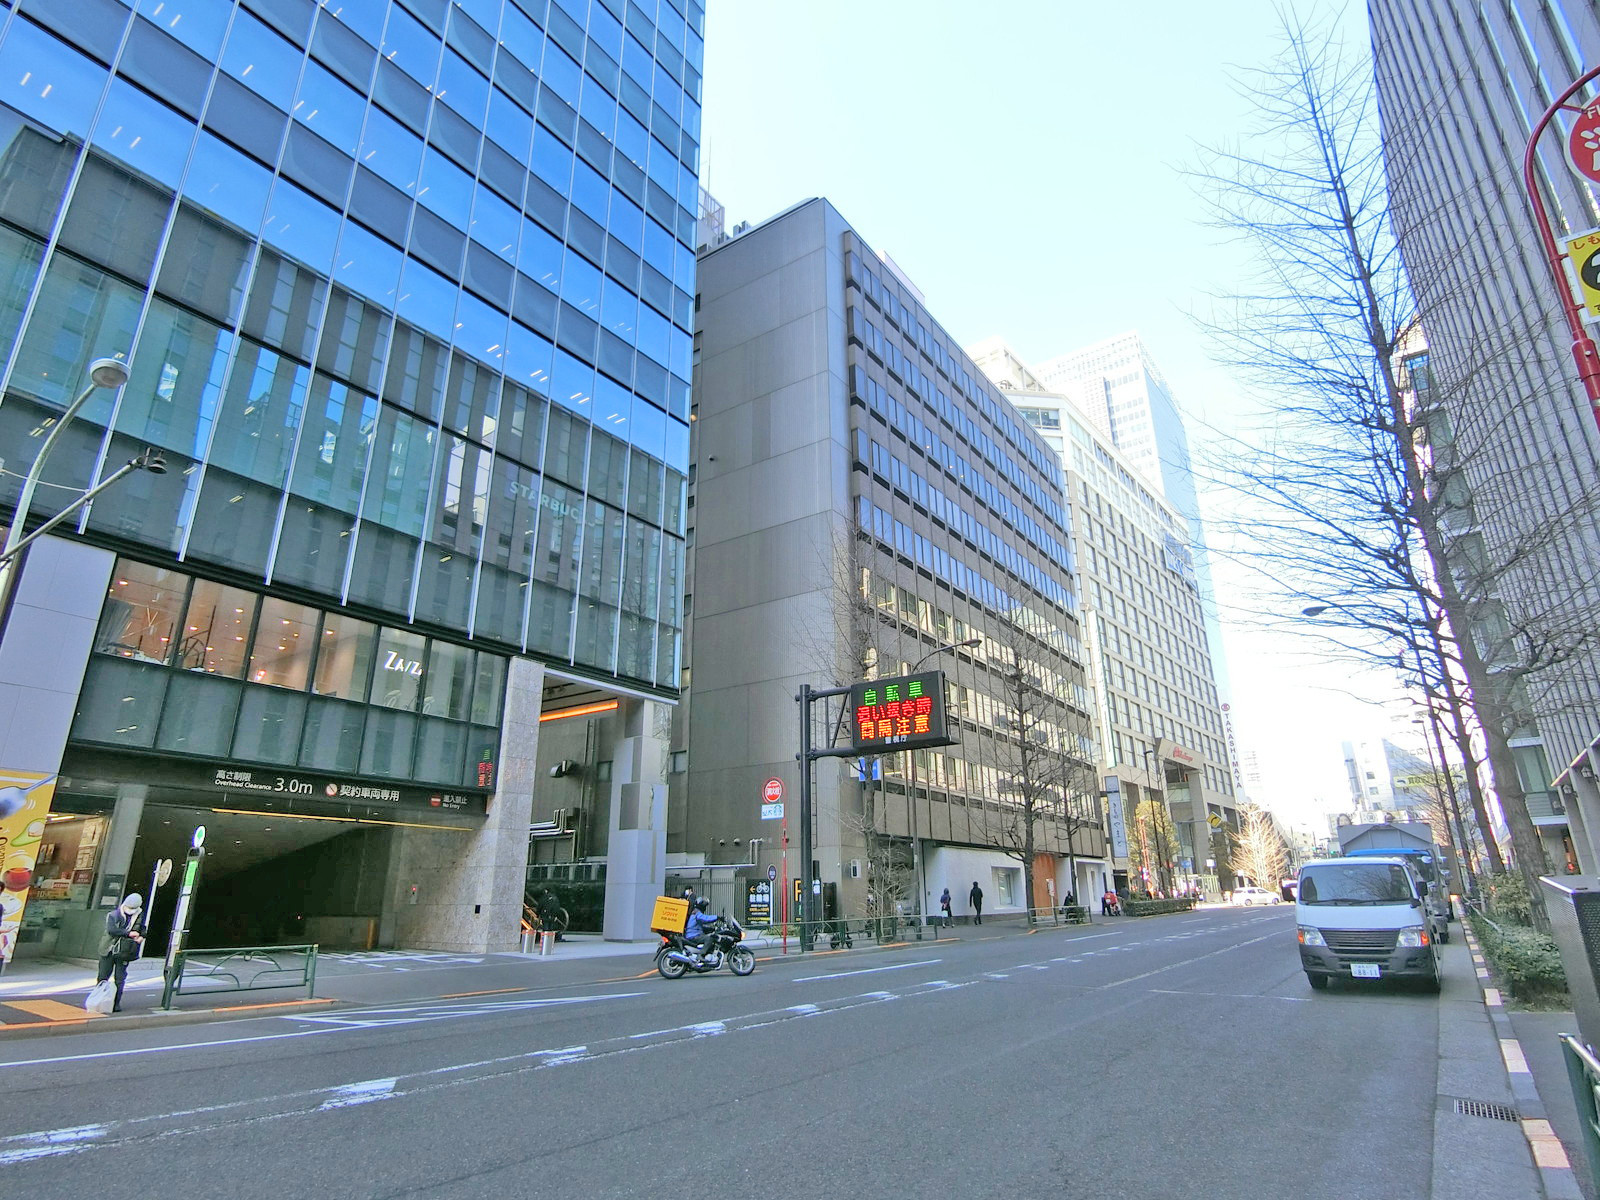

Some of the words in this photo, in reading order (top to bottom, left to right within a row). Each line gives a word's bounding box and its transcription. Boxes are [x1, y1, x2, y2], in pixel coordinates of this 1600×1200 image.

[864, 681, 923, 706] 自転車
[861, 714, 931, 740] 間隔注意
[1224, 713, 1243, 789] TAKASHIMAYA
[215, 769, 252, 781] 高さ制限
[214, 778, 244, 788] Overhead
[244, 781, 272, 791] Clearance
[274, 777, 313, 795] 3.0m
[339, 784, 400, 802] 契約車両専用
